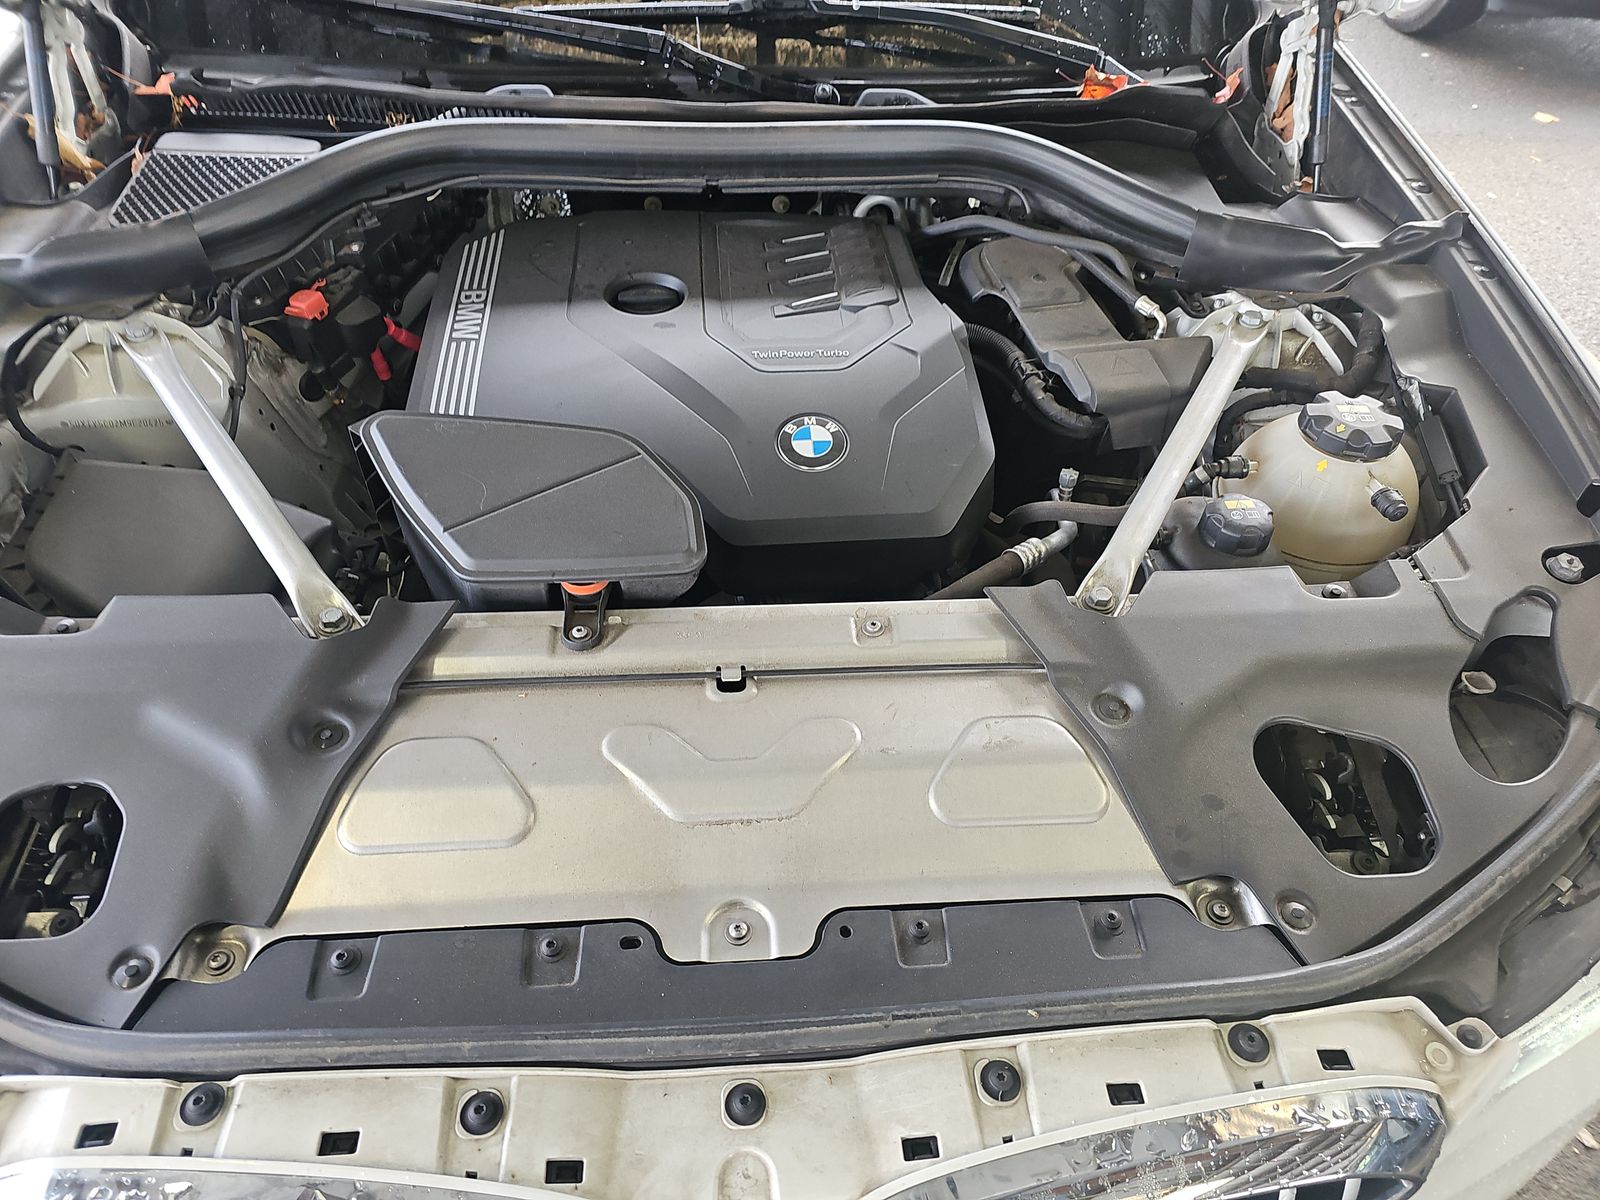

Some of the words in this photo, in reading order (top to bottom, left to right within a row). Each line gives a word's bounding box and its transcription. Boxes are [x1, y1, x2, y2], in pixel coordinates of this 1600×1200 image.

[452, 289, 487, 340] BMW
[816, 348, 850, 358] Turbo
[783, 416, 840, 435] BMW
